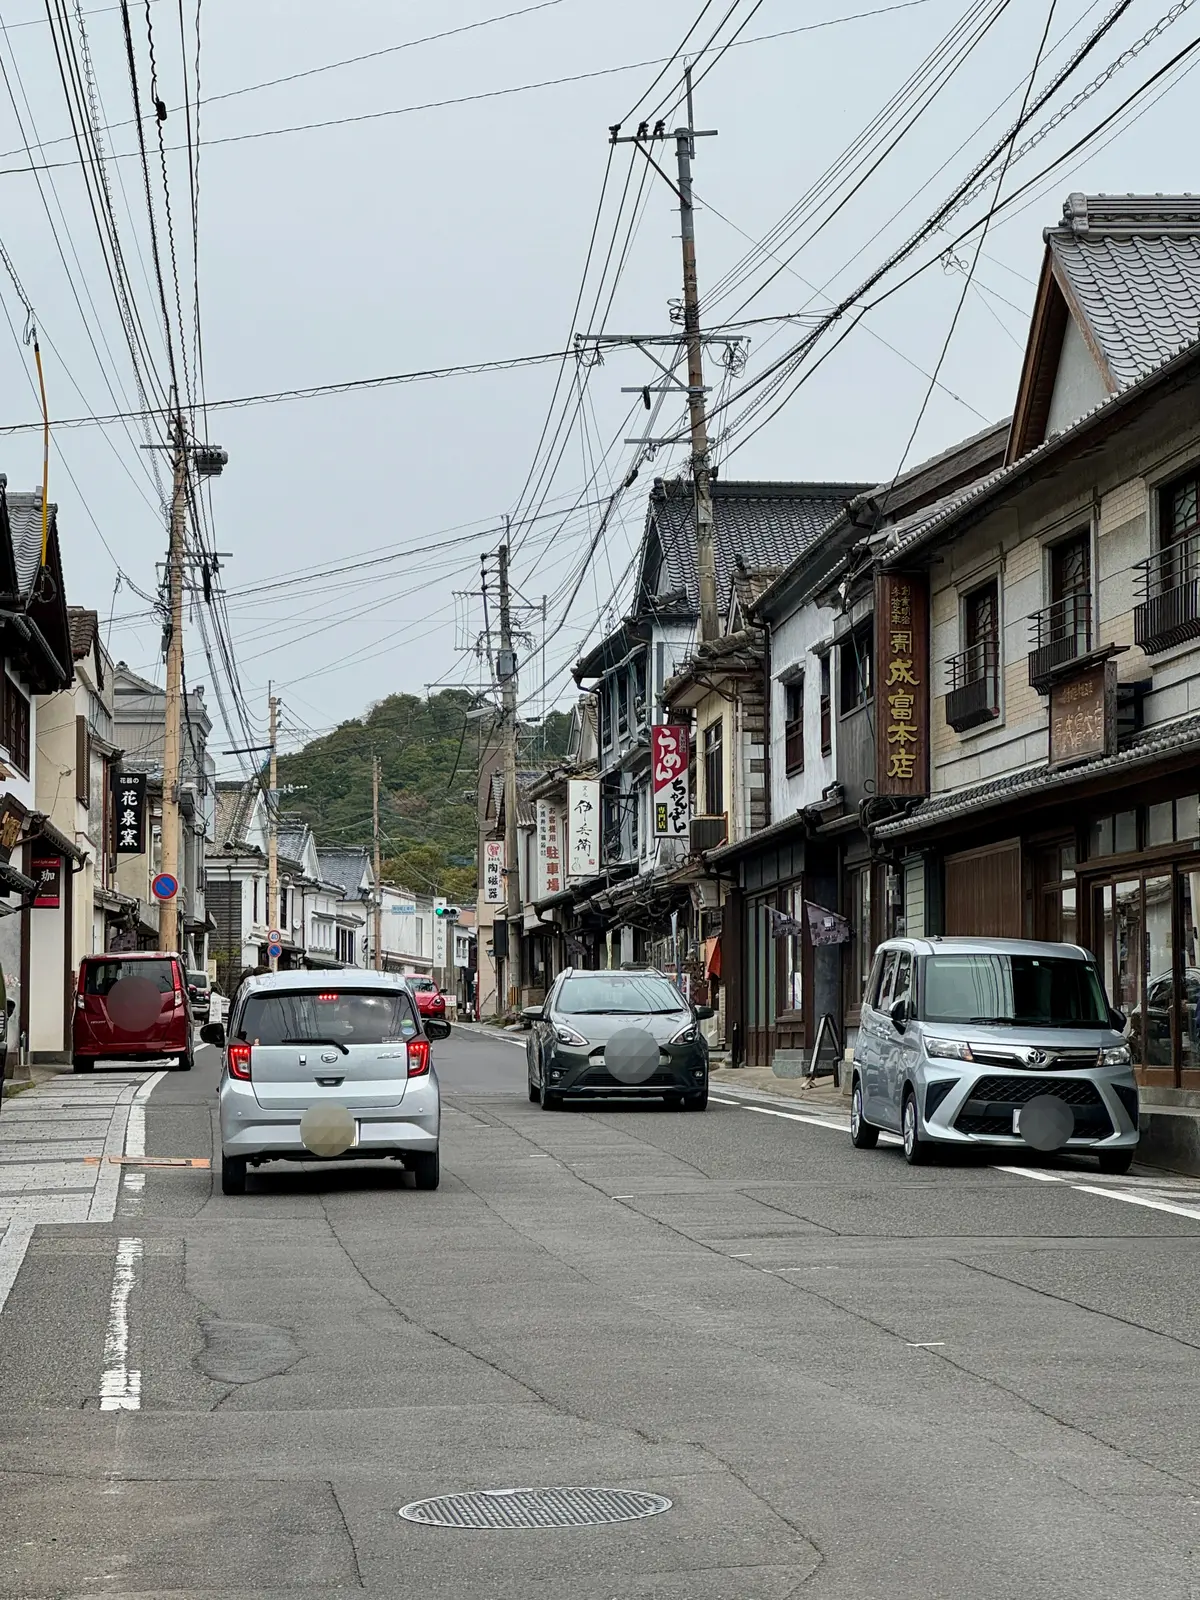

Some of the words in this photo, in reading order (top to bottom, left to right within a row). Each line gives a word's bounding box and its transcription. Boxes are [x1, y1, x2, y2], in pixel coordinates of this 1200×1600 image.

[119, 790, 138, 846] 花泉窯
[548, 807, 557, 842] お客様用
[658, 805, 666, 829] 専門店
[668, 777, 688, 833] ちゃんぽん
[574, 800, 594, 857] 伊兵衛
[488, 863, 498, 899] 陶磁器
[546, 846, 560, 891] 駐車場
